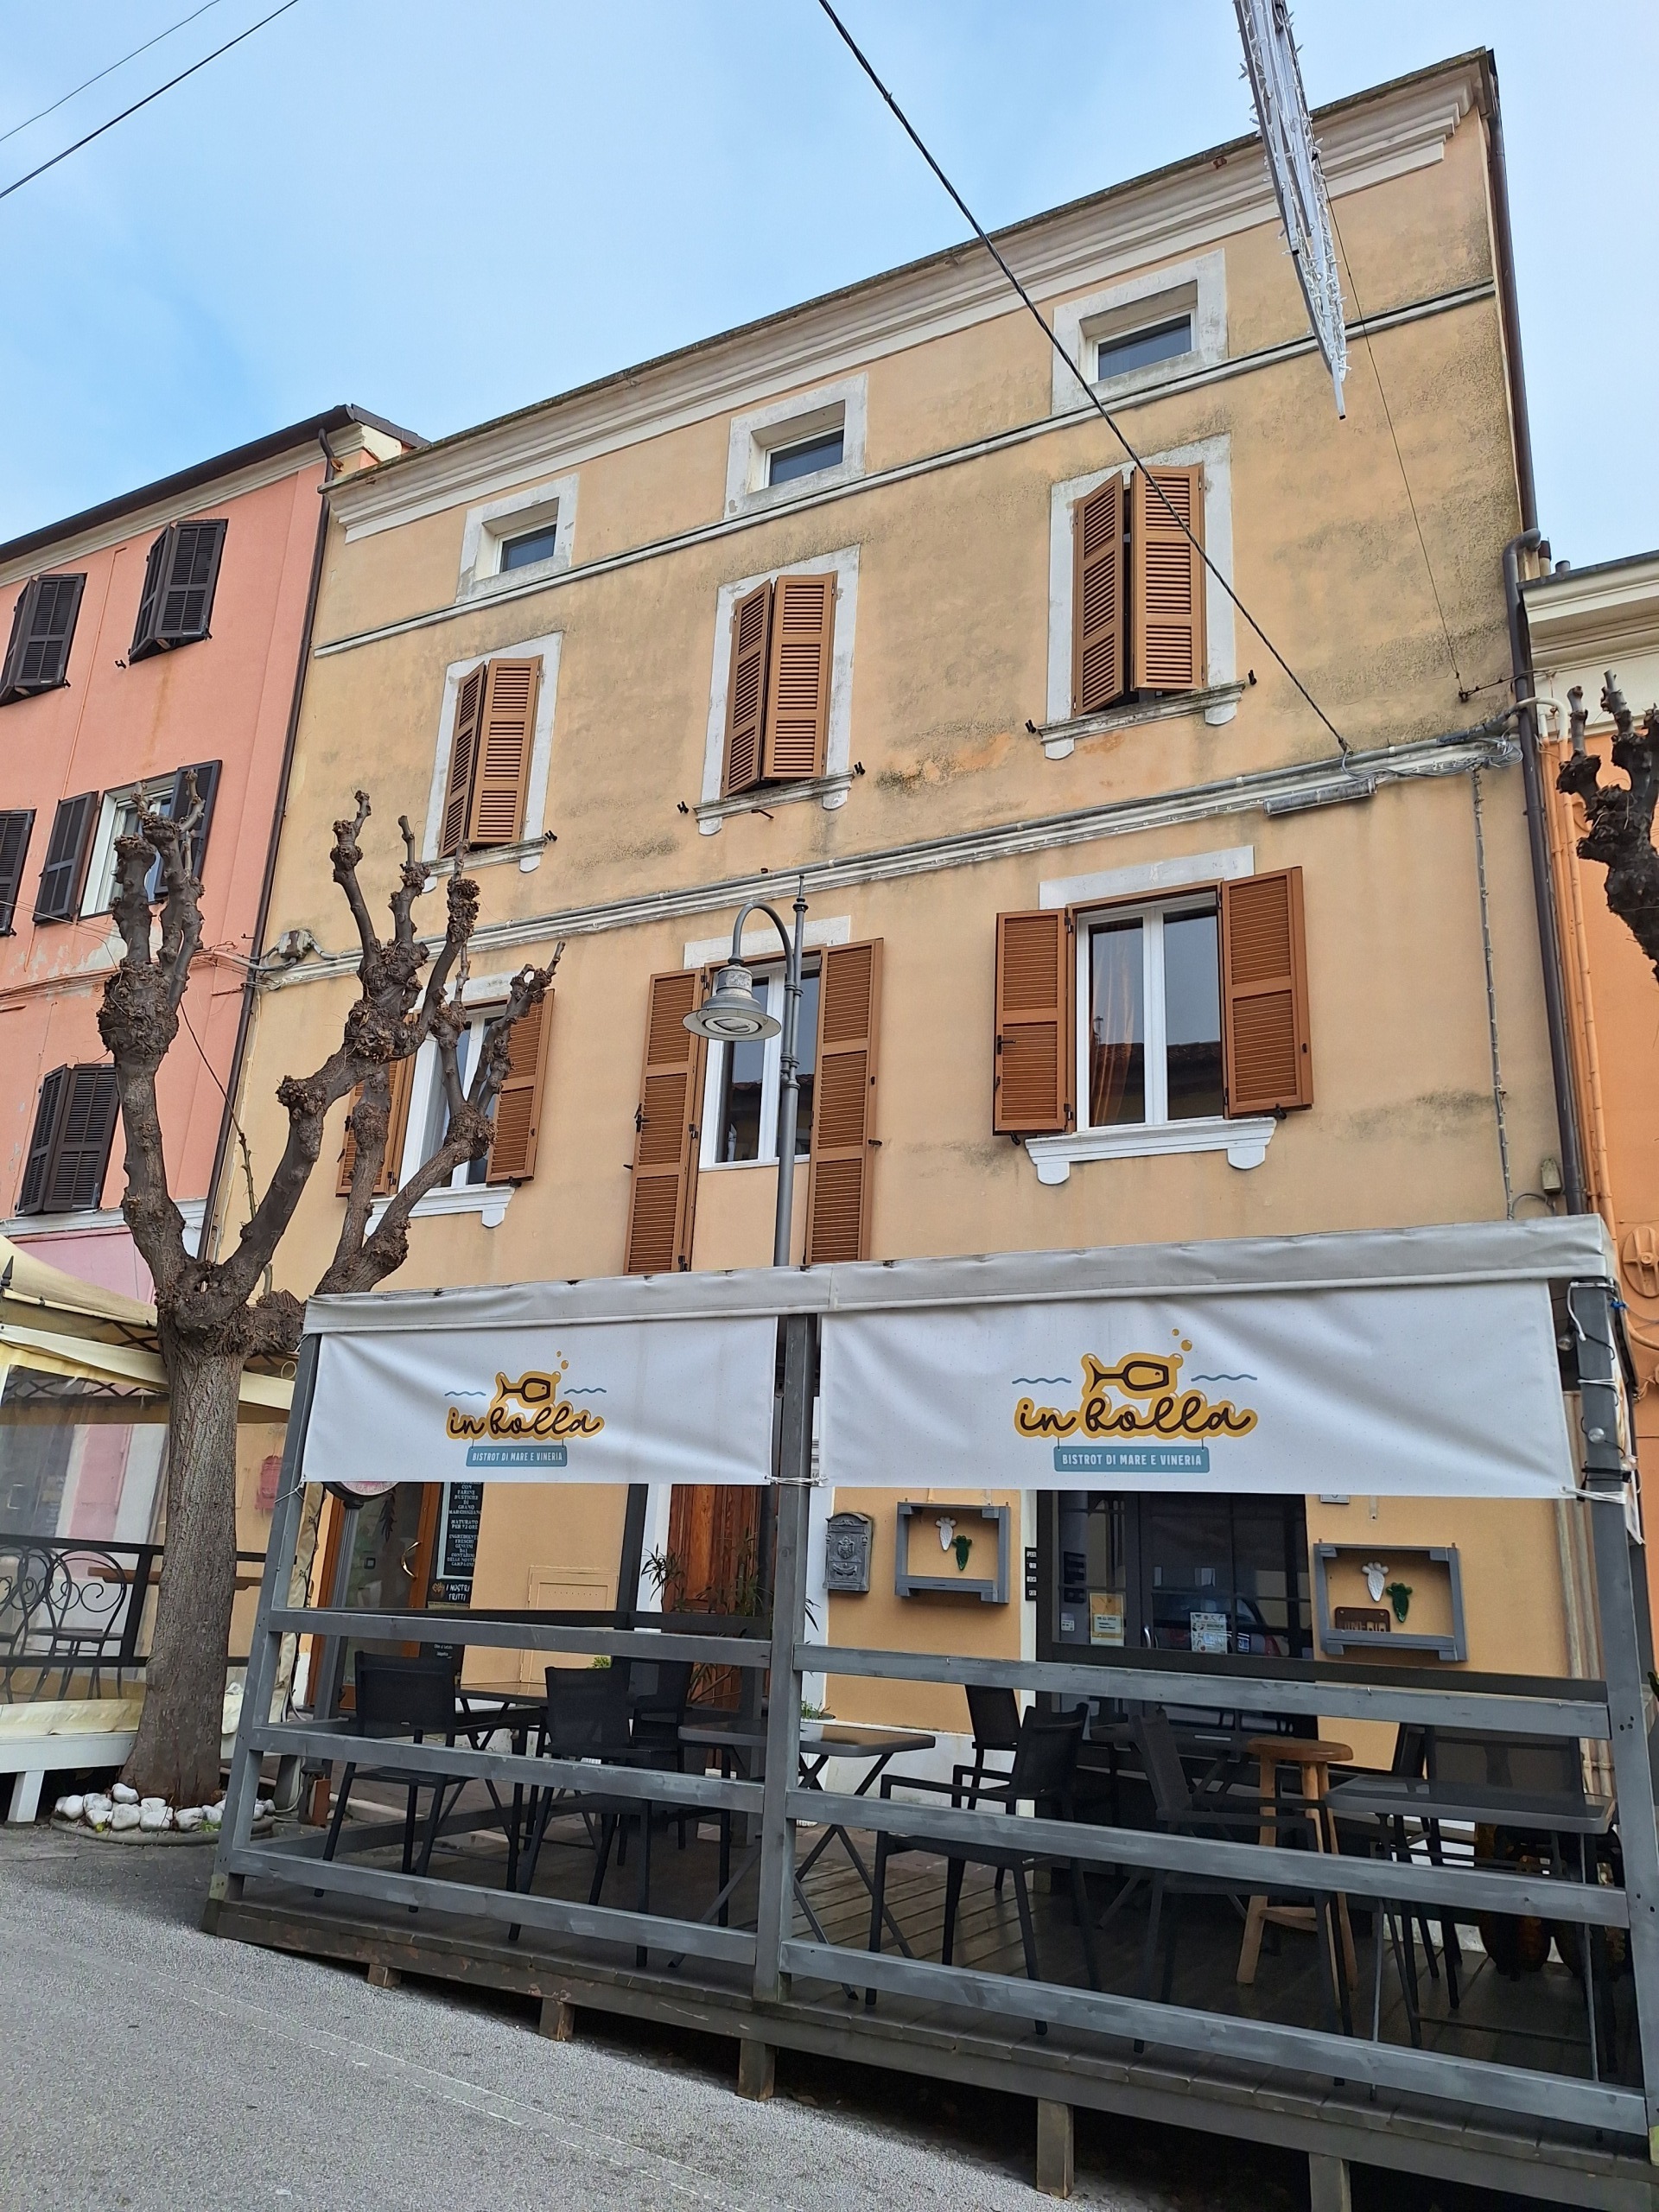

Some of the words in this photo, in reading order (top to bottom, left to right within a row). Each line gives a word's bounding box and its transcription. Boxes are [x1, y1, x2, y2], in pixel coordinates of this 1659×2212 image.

[448, 1410, 486, 1435] in
[1020, 1402, 1077, 1433] in
[472, 1452, 499, 1461] BISTROT
[501, 1452, 509, 1461] DI
[510, 1452, 529, 1461] MARE
[530, 1452, 535, 1461] E
[536, 1452, 563, 1461] VINERIA
[1062, 1454, 1103, 1465] BISTROT
[1106, 1454, 1116, 1465] DI
[1120, 1454, 1147, 1465] MARE
[1151, 1454, 1157, 1465] E
[1160, 1454, 1202, 1466] VINERIA
[449, 1583, 471, 1592] NOSTRI
